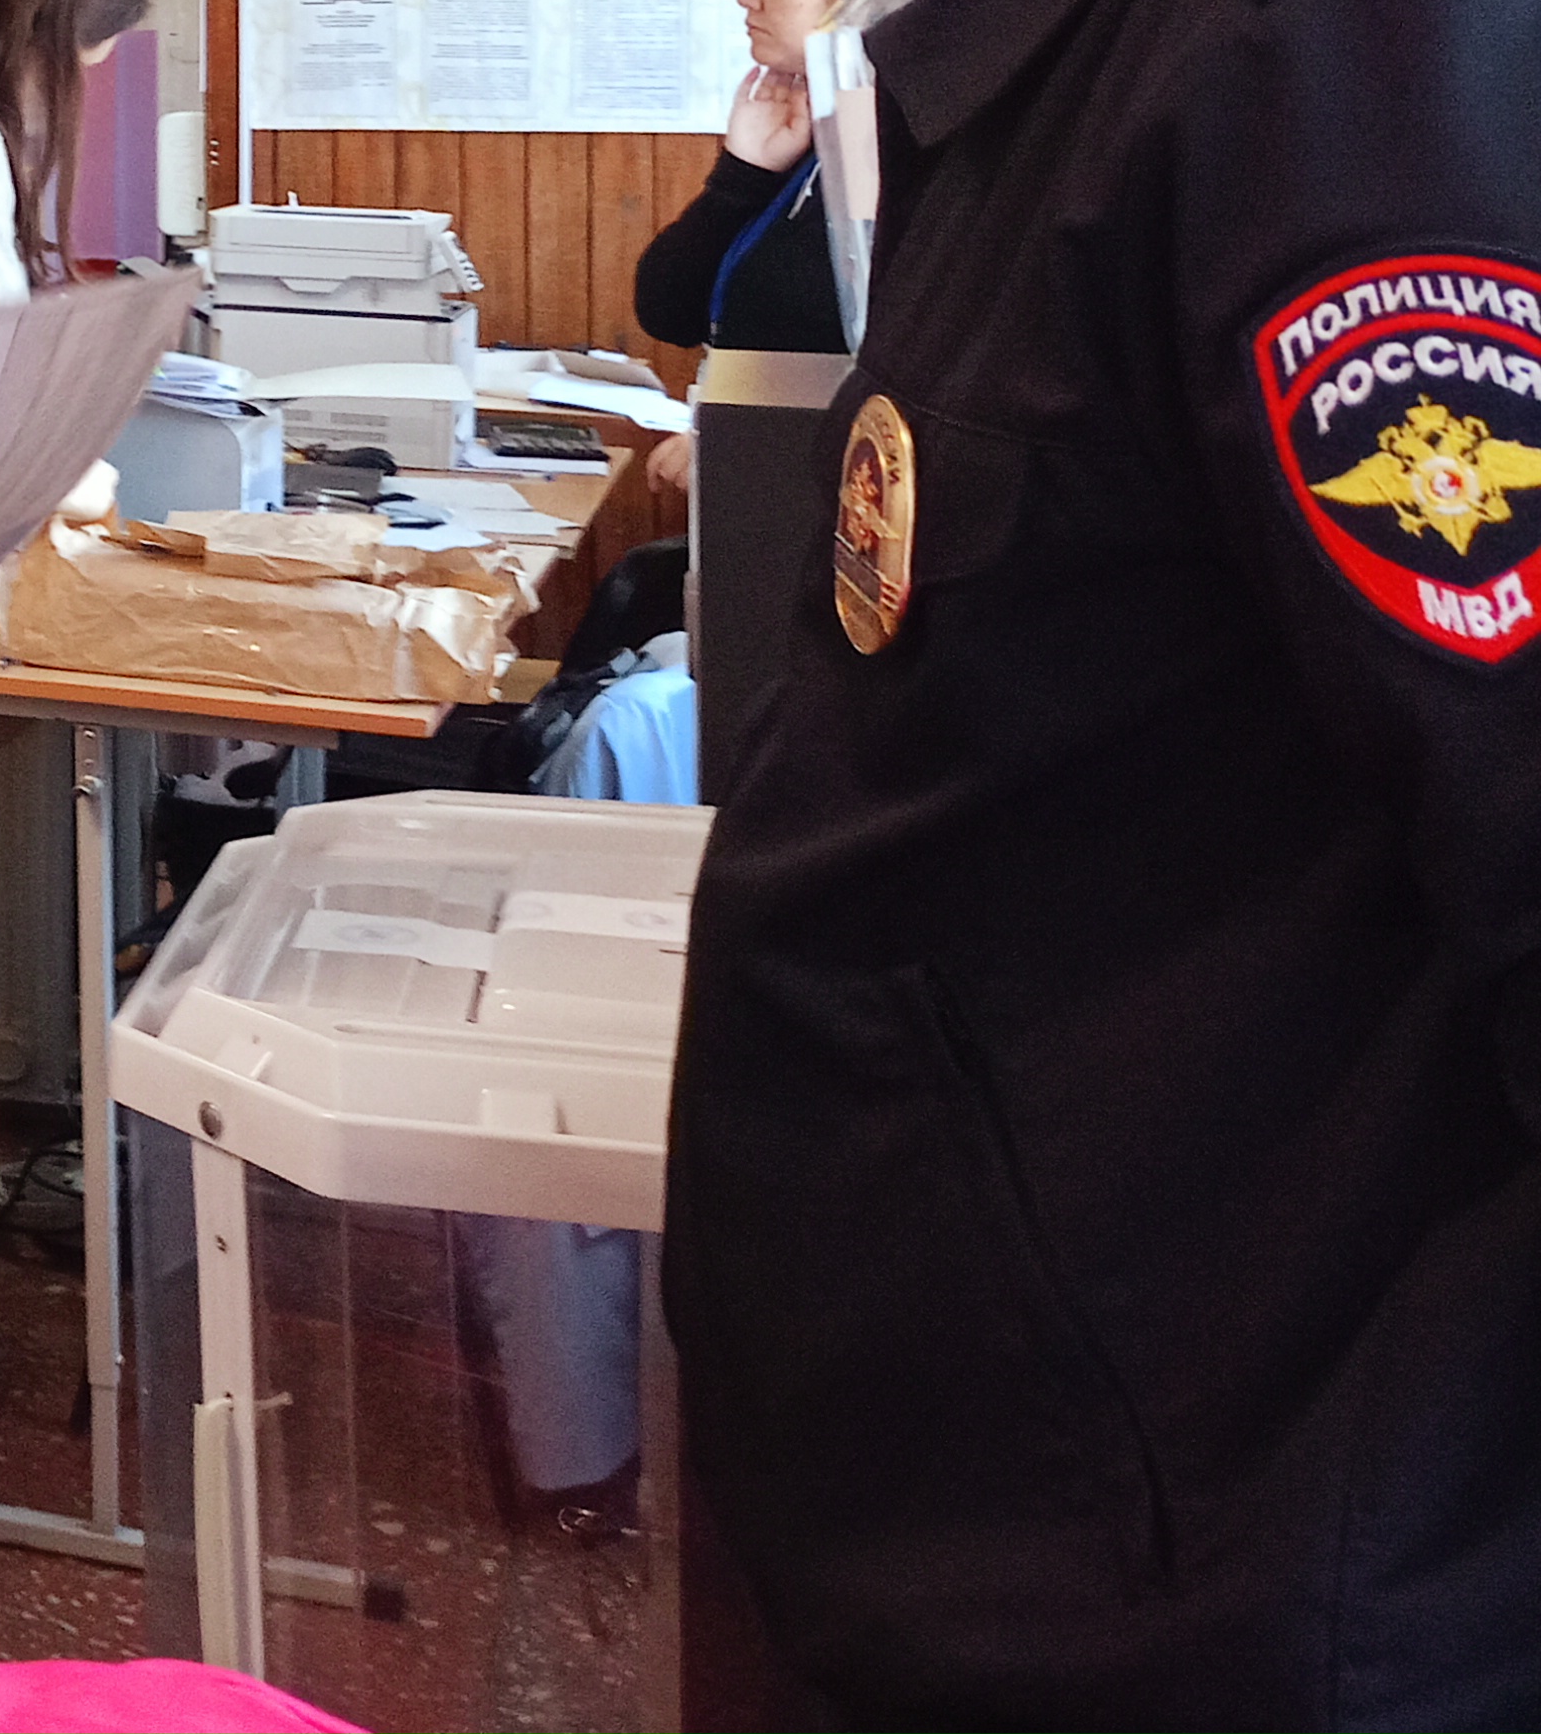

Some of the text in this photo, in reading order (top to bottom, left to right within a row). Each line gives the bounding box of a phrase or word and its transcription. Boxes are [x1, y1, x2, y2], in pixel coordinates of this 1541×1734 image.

[1278, 274, 1541, 376] ПОЛИЦИЯ
[1311, 335, 1541, 435] РОССИЯ
[1417, 571, 1533, 639] МВД
